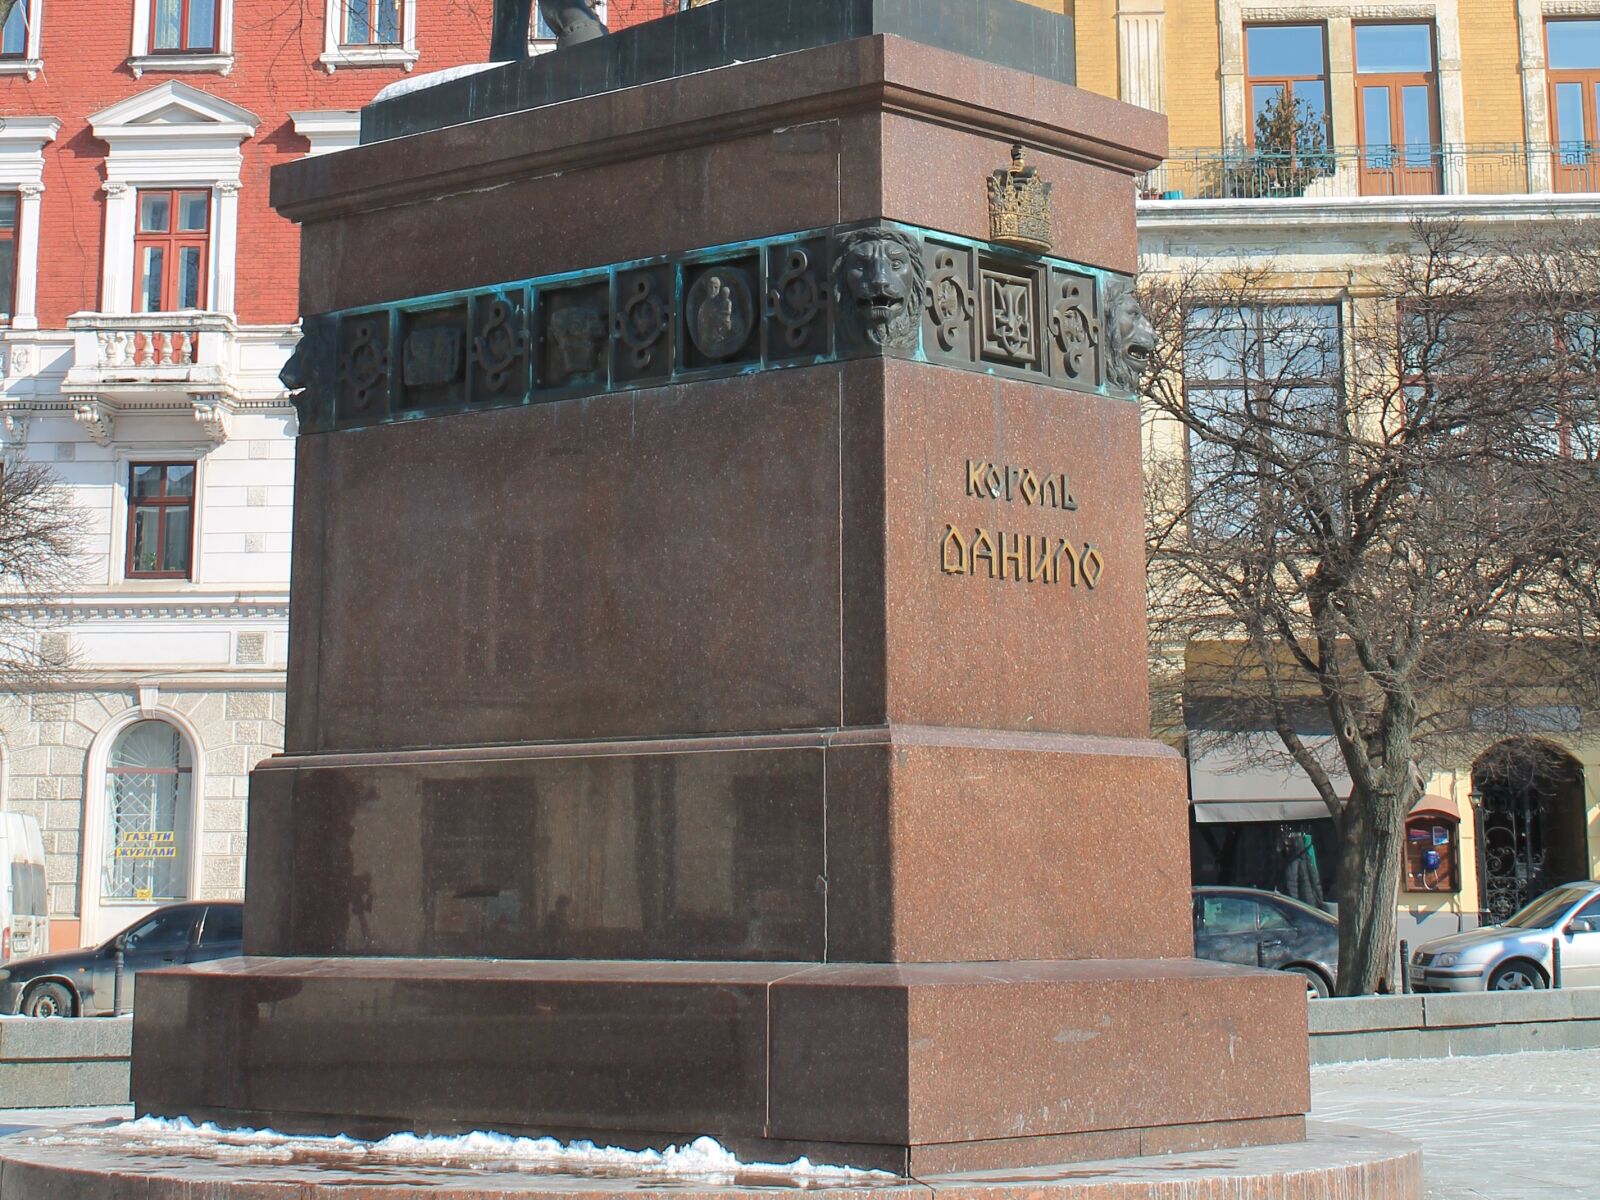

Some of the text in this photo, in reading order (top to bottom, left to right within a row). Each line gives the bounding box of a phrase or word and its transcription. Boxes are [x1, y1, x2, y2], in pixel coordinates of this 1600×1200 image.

[966, 459, 1078, 511] КОРОЛЬ
[941, 524, 1105, 590] ДАНИЛО
[126, 832, 172, 841] ГАЗЕТИ
[118, 848, 175, 857] ЖУРНАЛИ
